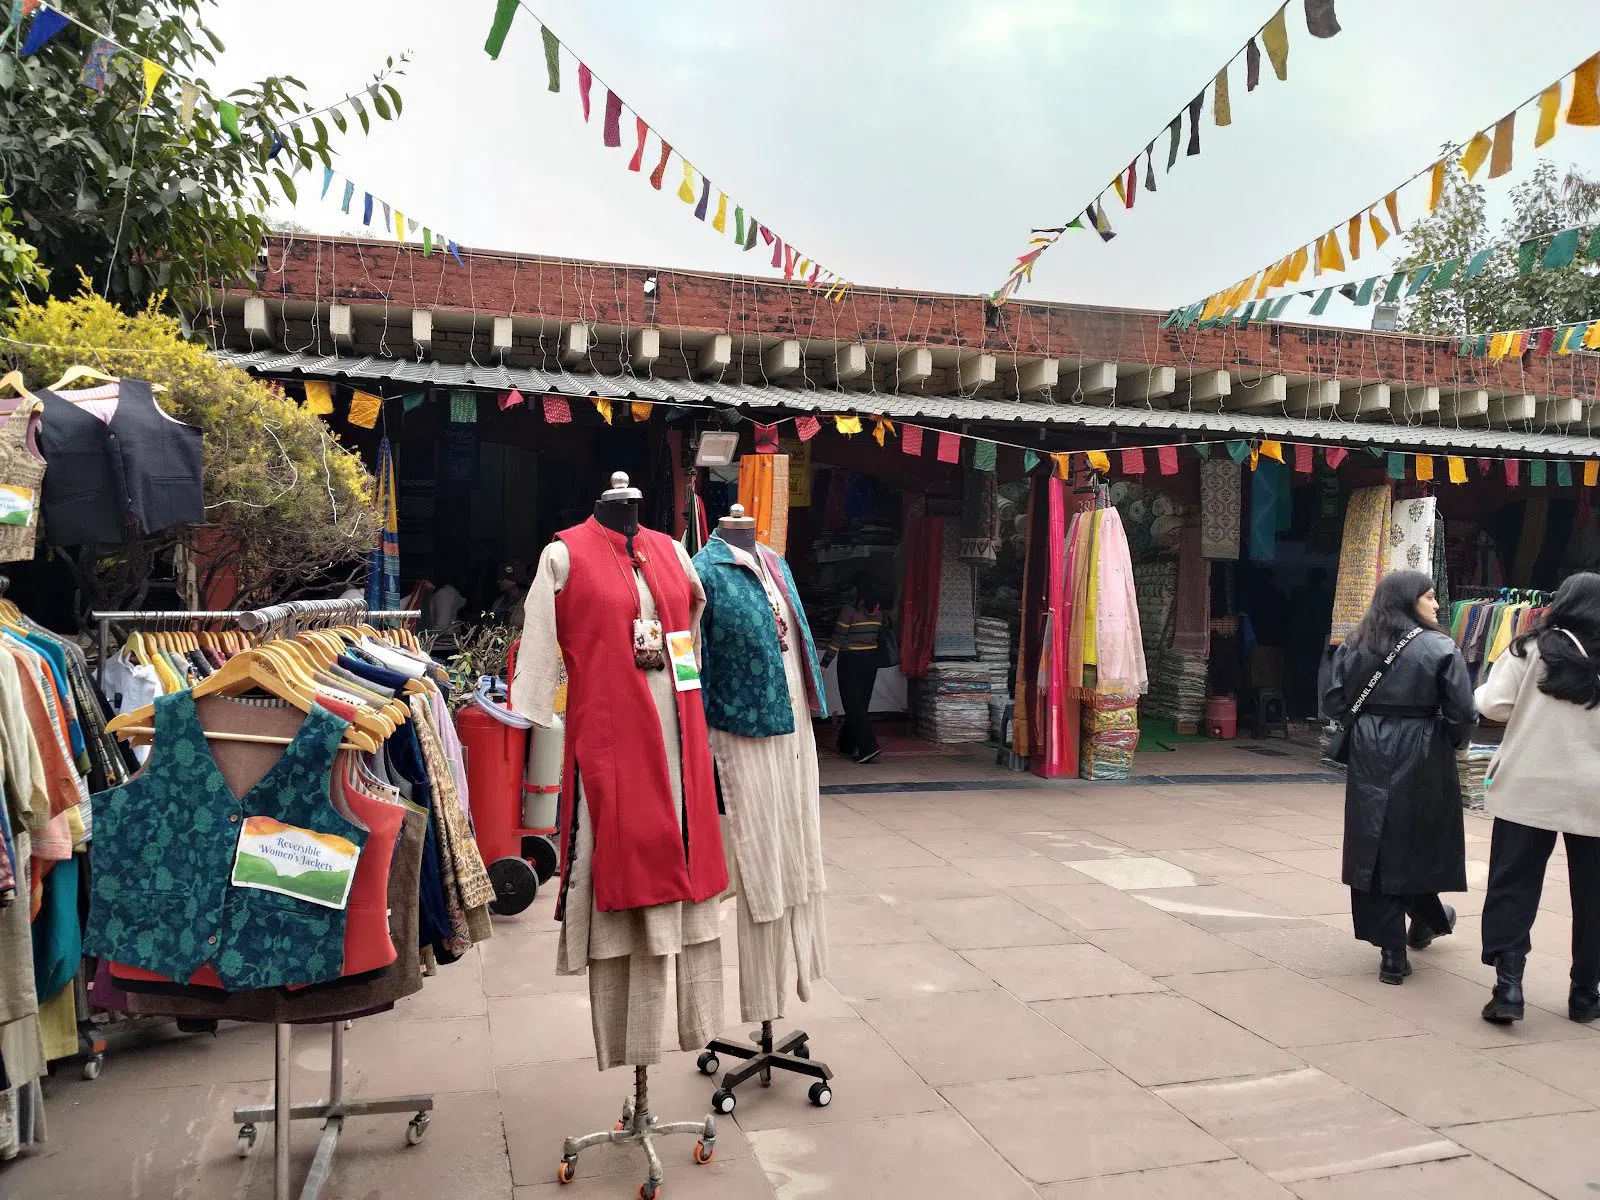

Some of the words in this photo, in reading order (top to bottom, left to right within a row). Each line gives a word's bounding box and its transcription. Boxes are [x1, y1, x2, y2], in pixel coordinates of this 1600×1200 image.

[1351, 688, 1371, 713] MICHAEL
[1368, 671, 1382, 688] KORS
[259, 844, 299, 862] Women's
[300, 855, 333, 871] Jackets
[276, 837, 321, 857] Reversible
